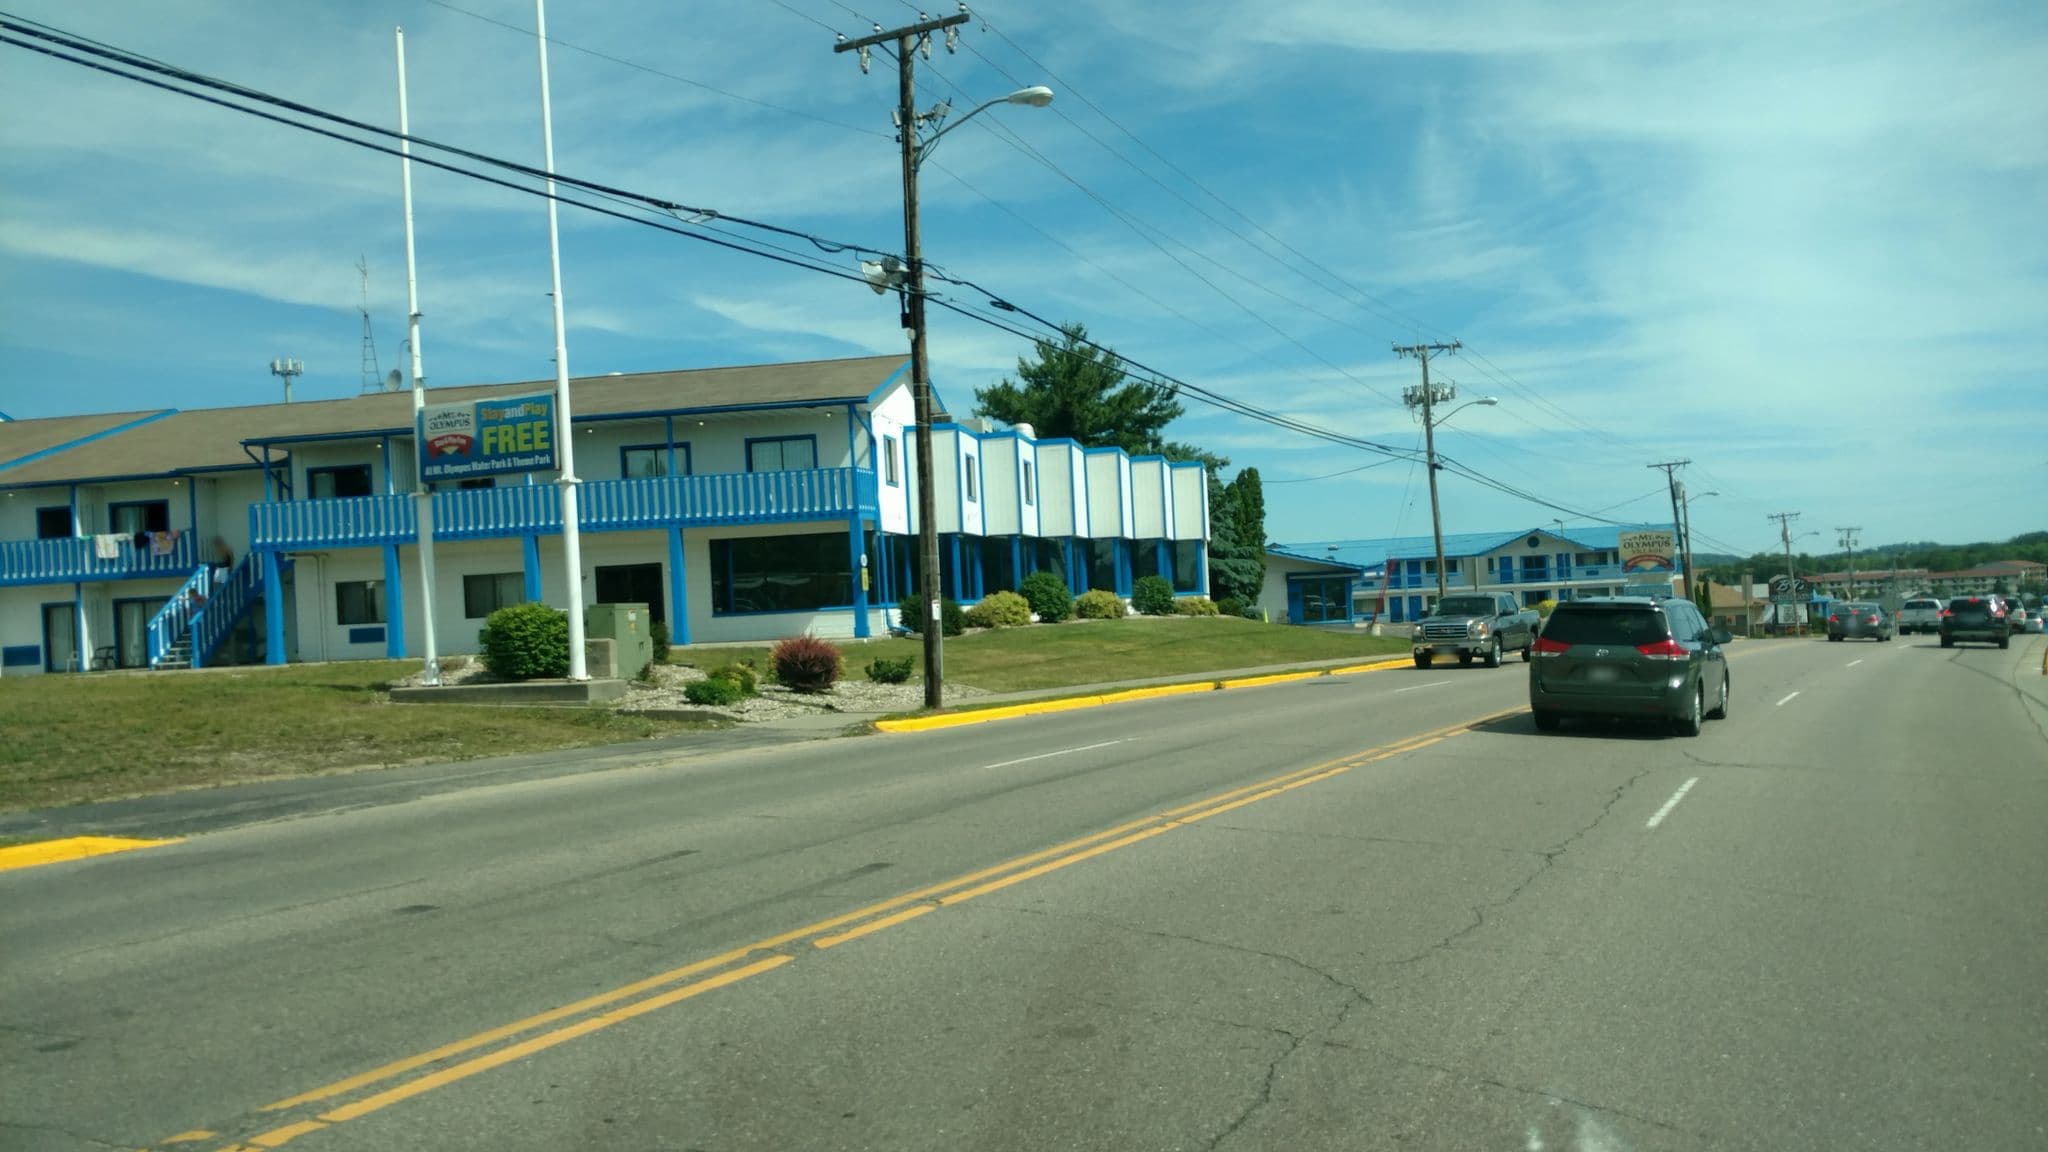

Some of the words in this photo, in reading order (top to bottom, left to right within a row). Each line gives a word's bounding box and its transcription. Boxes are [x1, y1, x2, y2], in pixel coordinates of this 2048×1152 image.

[430, 417, 471, 430] OLYMPUS
[483, 420, 550, 455] FREE
[491, 458, 505, 469] Park
[513, 456, 534, 468] Theme
[534, 453, 551, 465] Park
[1623, 540, 1671, 548] OLYMPUS
